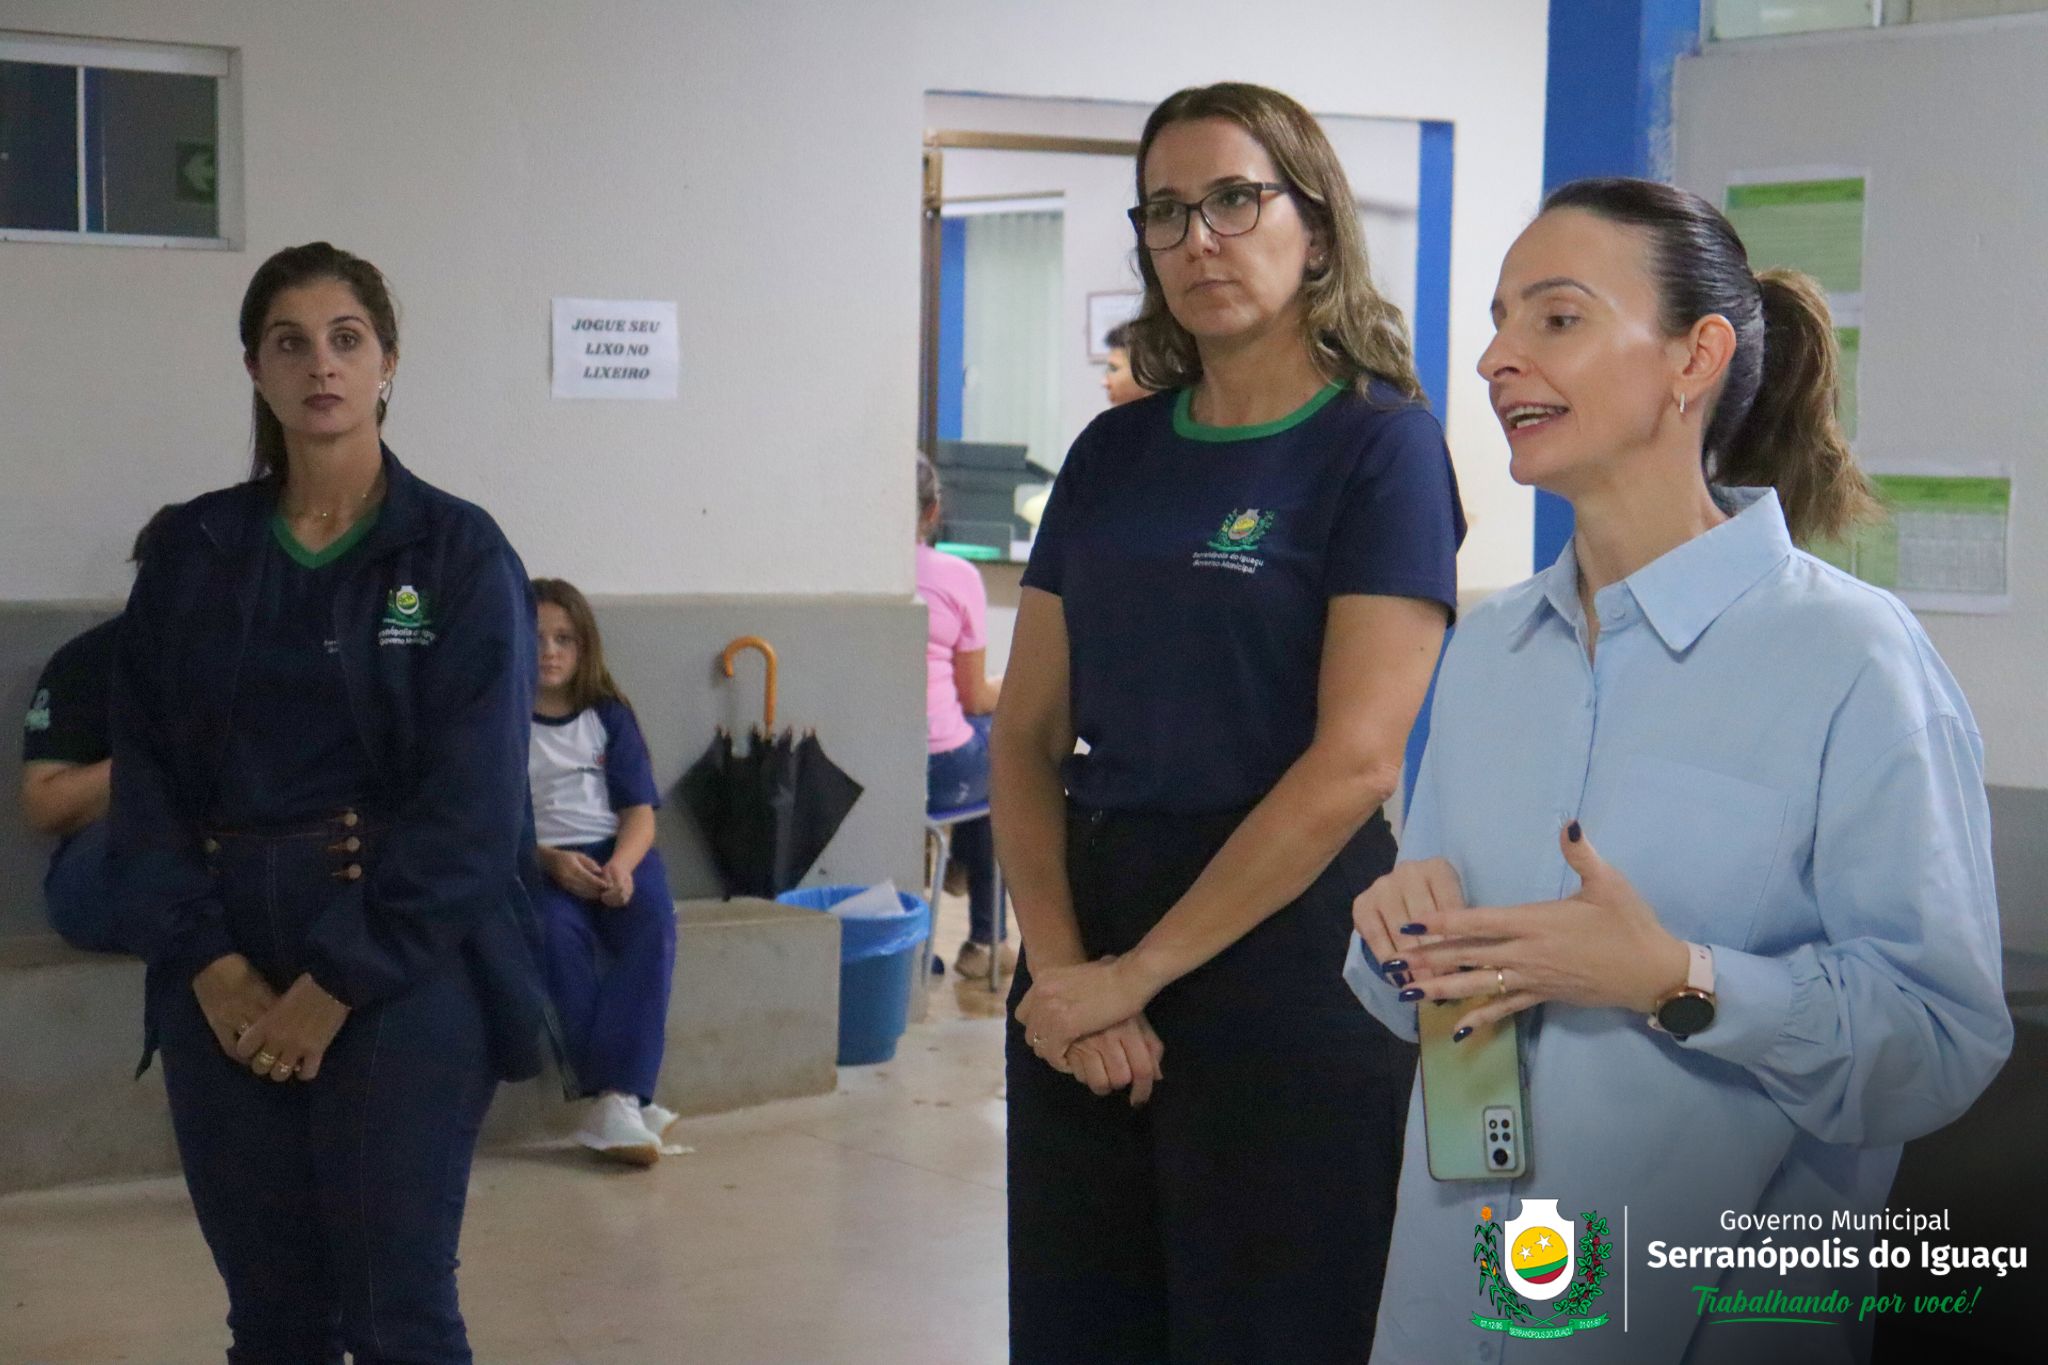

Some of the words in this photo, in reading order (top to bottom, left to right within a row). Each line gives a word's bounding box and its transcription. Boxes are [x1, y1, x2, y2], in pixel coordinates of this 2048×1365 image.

[571, 318, 626, 332] JOGUE
[628, 320, 661, 333] SEU
[585, 342, 625, 356] LIXO
[627, 343, 649, 356] NO
[583, 365, 651, 380] LIXEIRO
